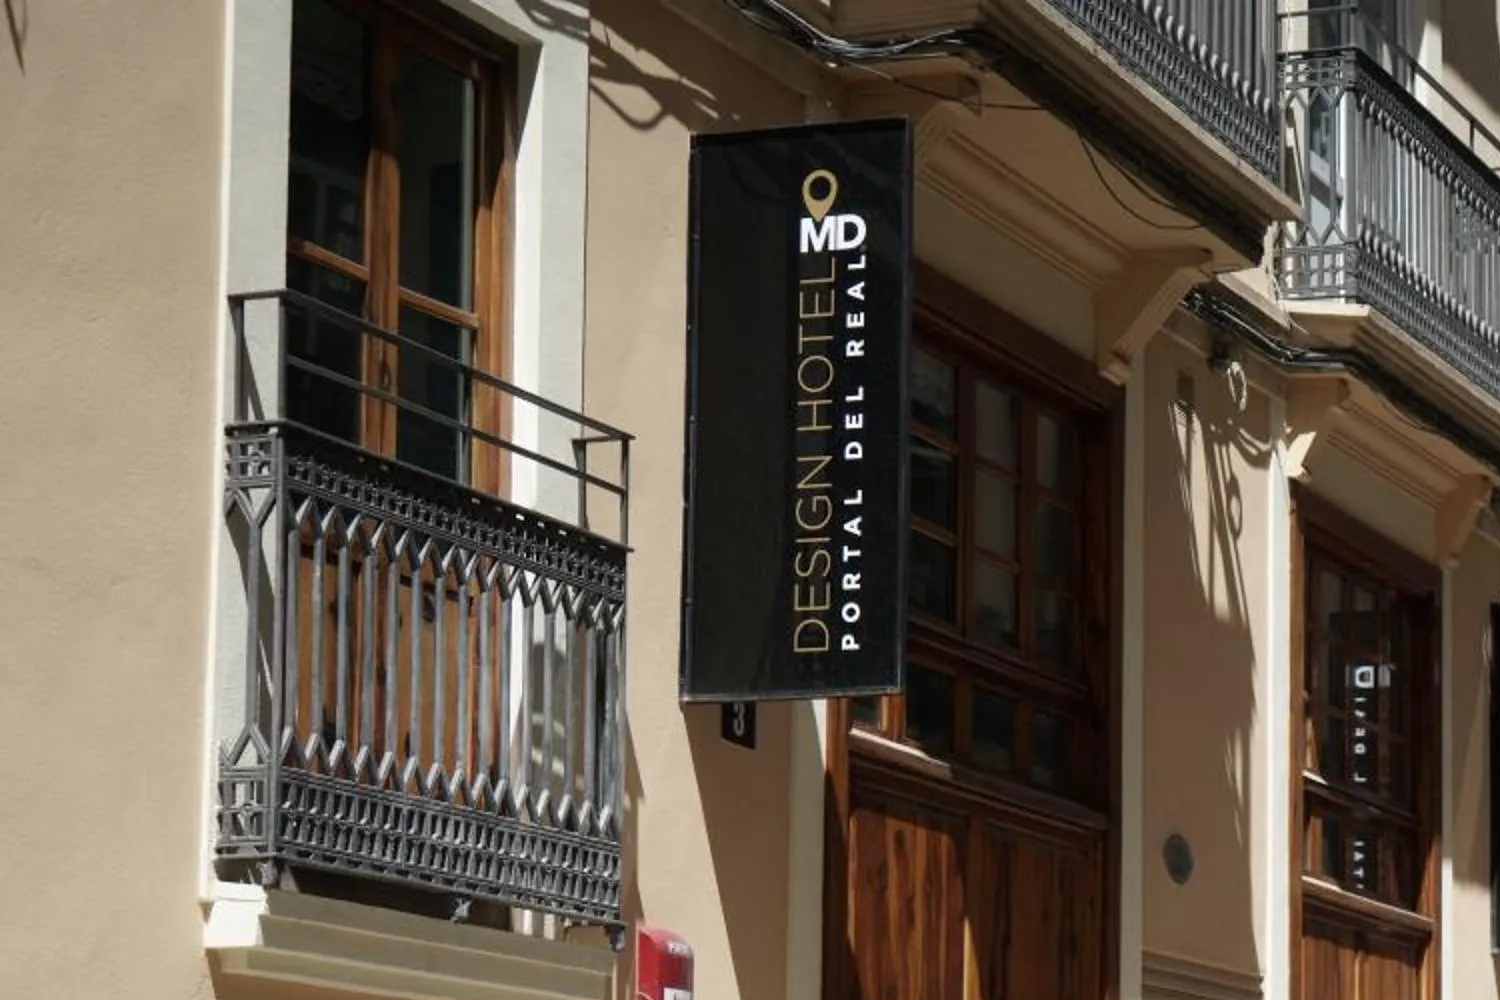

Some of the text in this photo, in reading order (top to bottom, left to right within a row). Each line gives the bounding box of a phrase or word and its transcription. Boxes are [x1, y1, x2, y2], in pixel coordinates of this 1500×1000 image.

[800, 214, 867, 253] MD
[794, 256, 836, 653] DESIGN HOTEL
[840, 253, 867, 652] PORTAL DEL REAL
